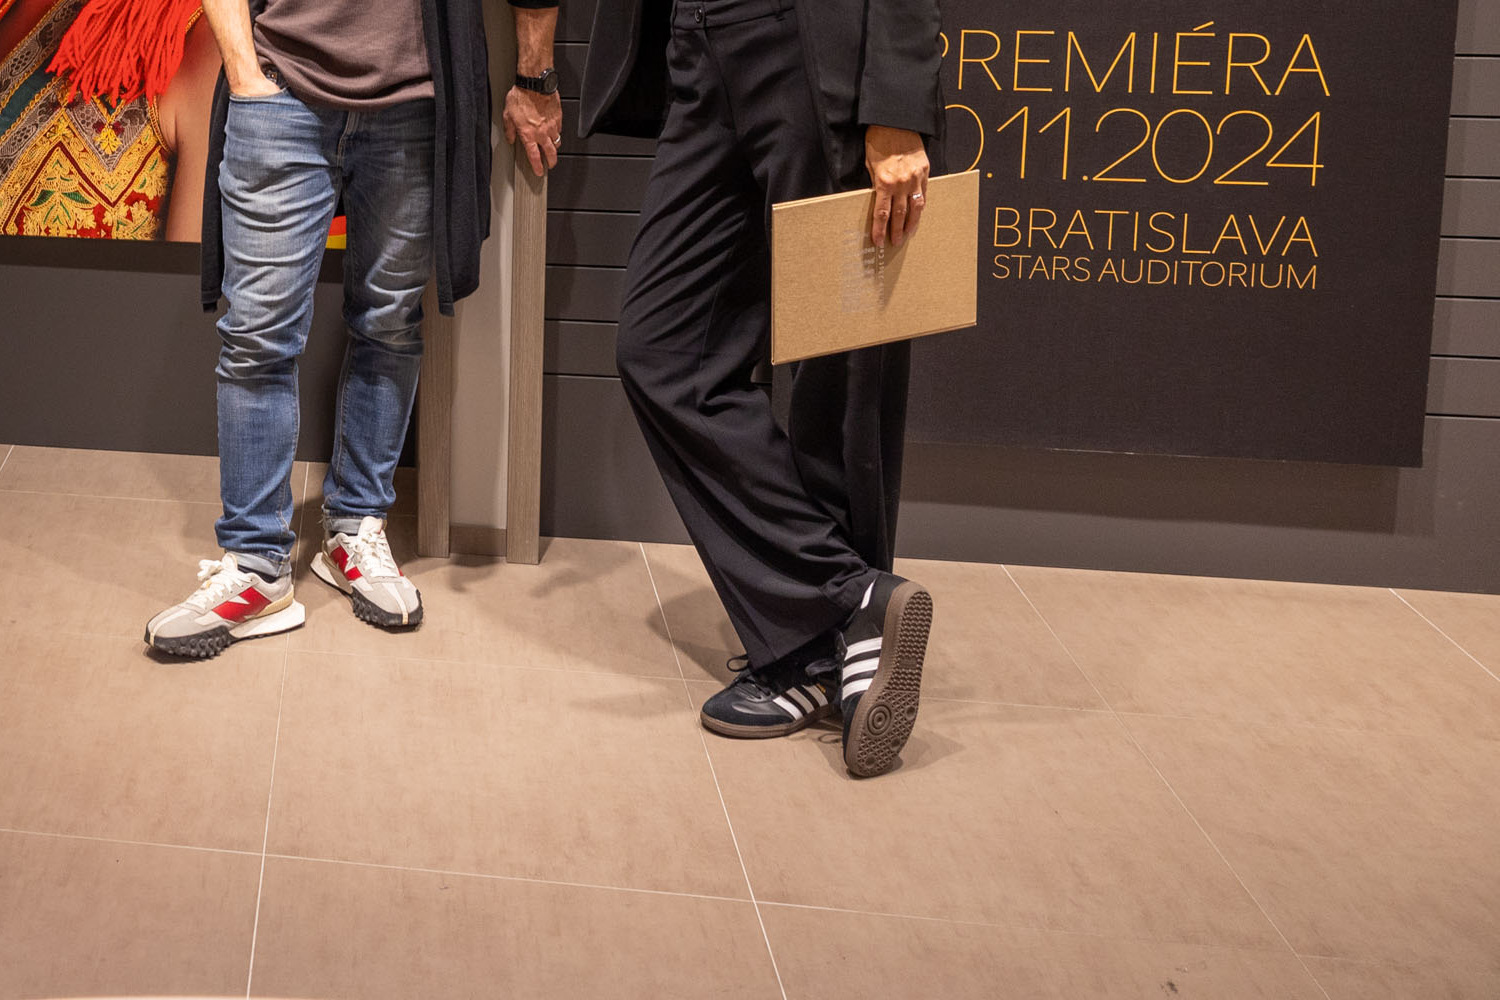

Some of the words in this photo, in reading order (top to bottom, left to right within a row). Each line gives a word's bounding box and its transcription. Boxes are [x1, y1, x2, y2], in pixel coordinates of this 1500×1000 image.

[944, 103, 1325, 188] 0.11.2024
[993, 206, 1319, 258] BRATISLAVA
[992, 253, 1091, 283] STARS
[1097, 257, 1319, 290] AUDITORIUM
